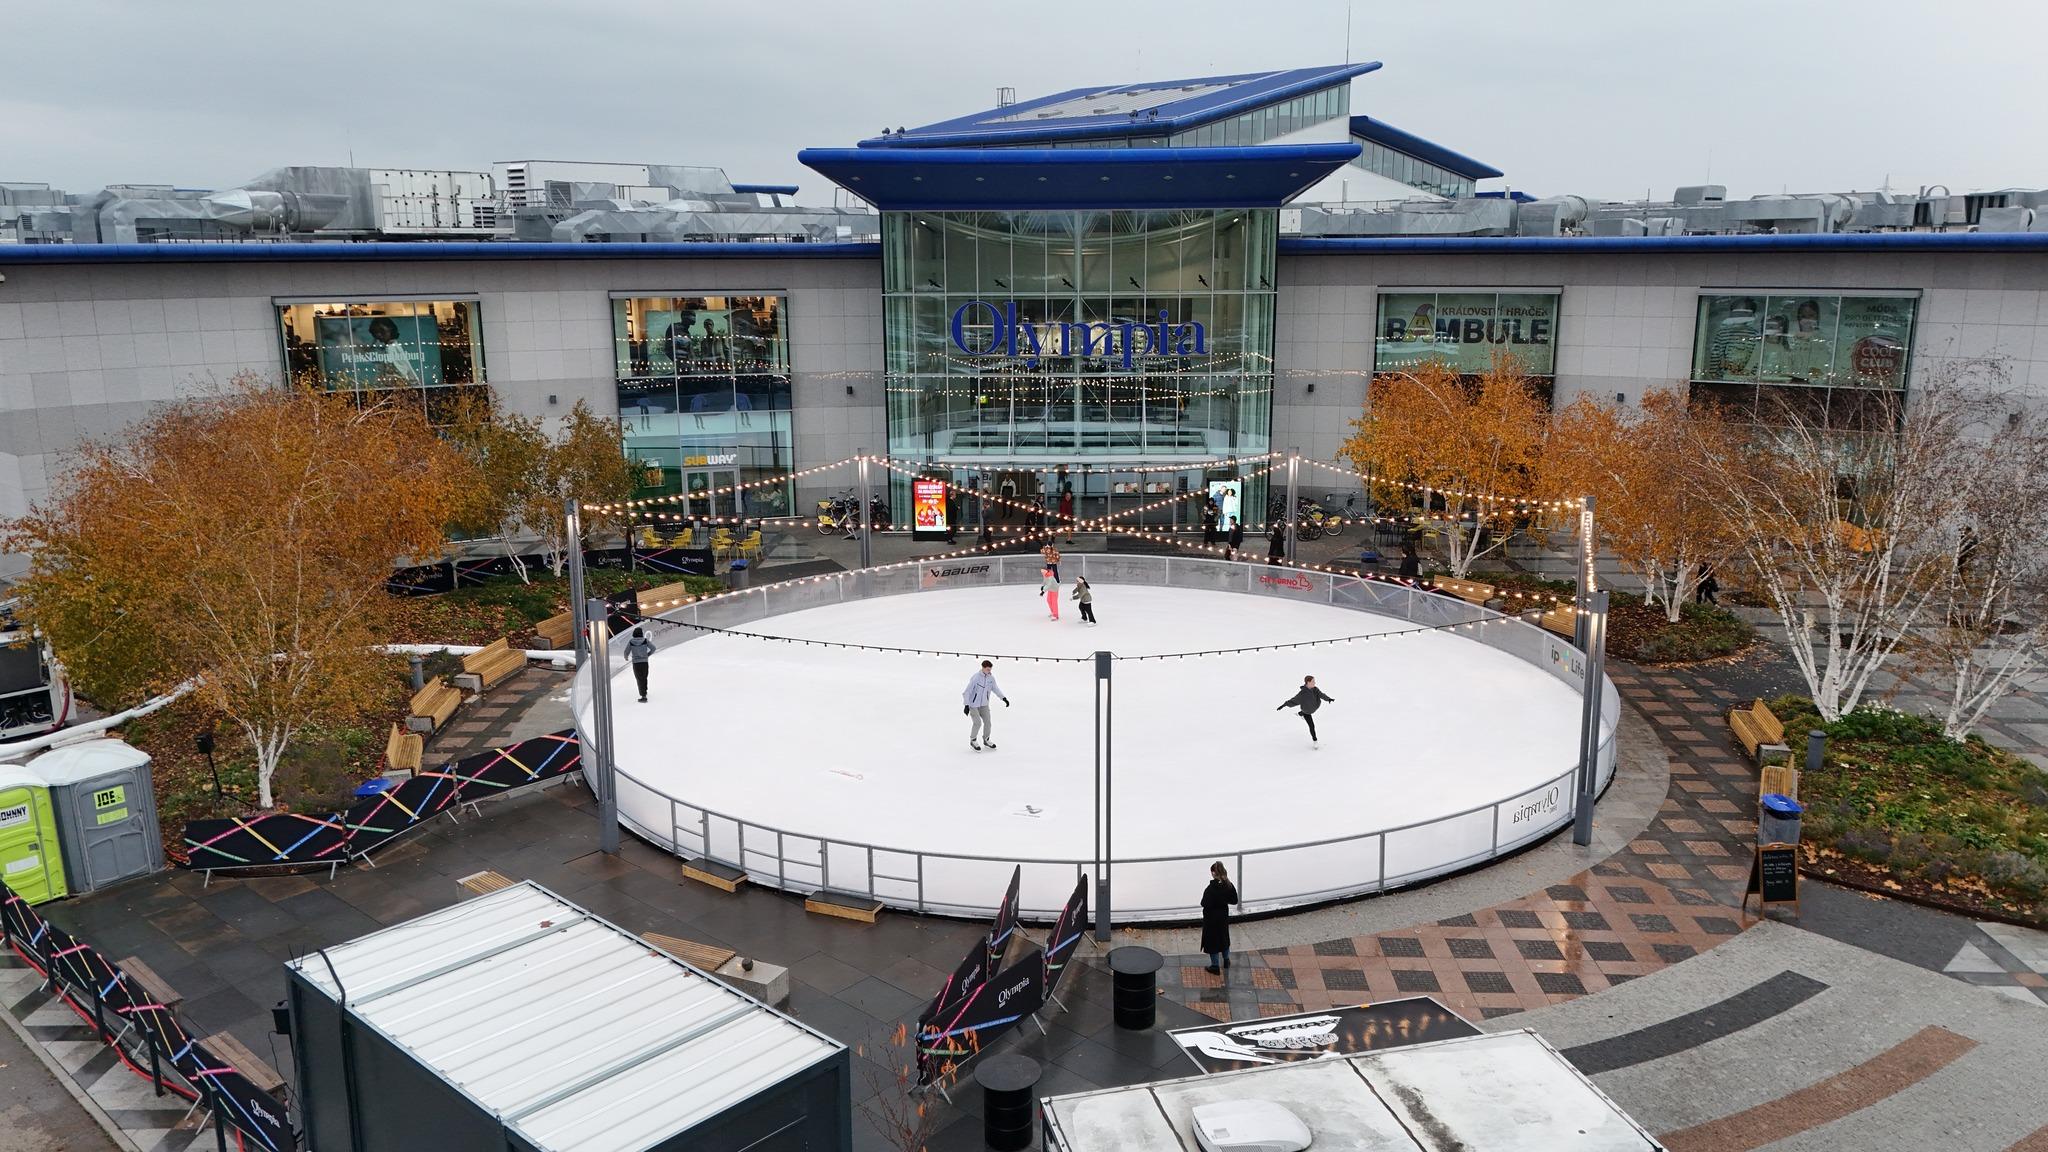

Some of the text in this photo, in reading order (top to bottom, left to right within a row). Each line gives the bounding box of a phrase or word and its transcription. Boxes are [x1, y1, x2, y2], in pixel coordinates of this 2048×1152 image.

[1506, 303, 1549, 317] HRAČEK
[952, 301, 1210, 368] Olympia
[1387, 317, 1550, 344] BAMBULE
[1861, 346, 1895, 357] COOL
[1860, 358, 1893, 367] CLUB
[683, 454, 734, 465] SUBWAY
[941, 565, 990, 577] BAUER
[96, 790, 116, 807] JOE
[0, 806, 27, 822] OHNNY
[998, 977, 1030, 1003] Olympia
